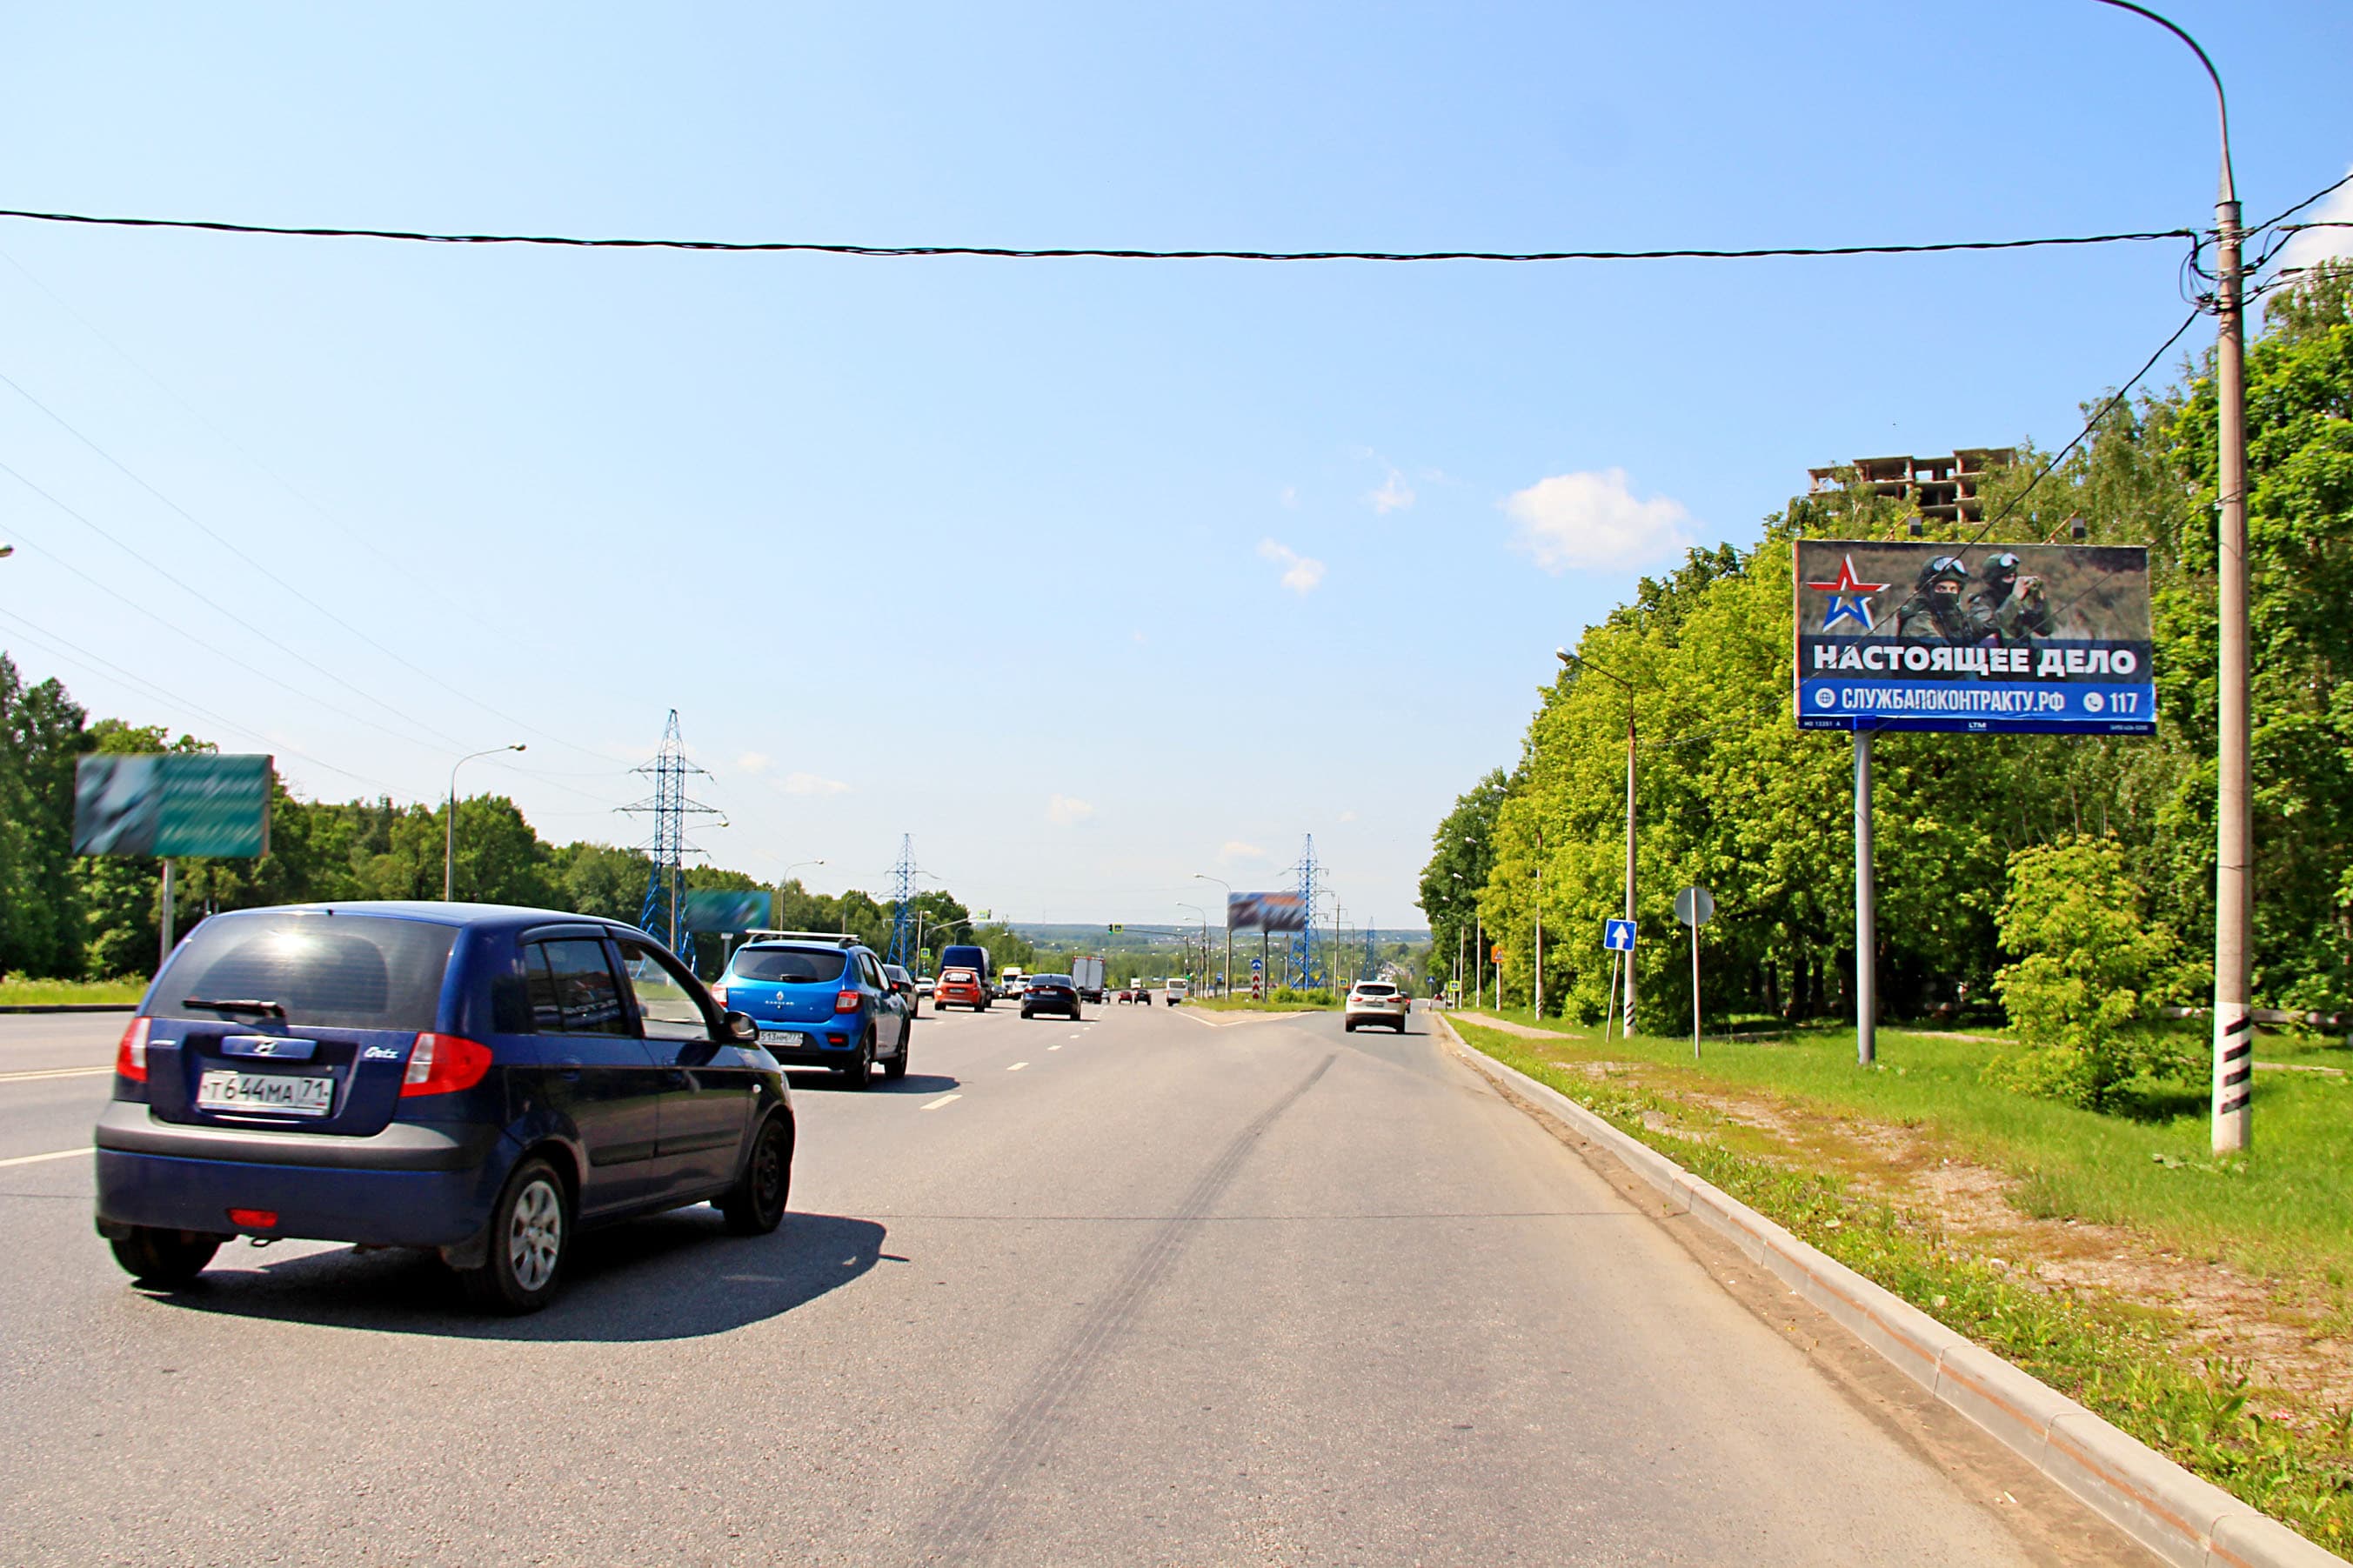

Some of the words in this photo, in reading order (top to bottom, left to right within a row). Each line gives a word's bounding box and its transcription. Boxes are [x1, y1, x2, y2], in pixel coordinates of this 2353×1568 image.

[1814, 644, 2031, 676] НАСТОЯЩЕЕ
[2036, 649, 2137, 677] ДЕЛО
[1842, 687, 2066, 712] СЛУЖБАПОКОНТРАКТУ.РФ
[2109, 692, 2139, 713] 117
[364, 1045, 399, 1059] Getz
